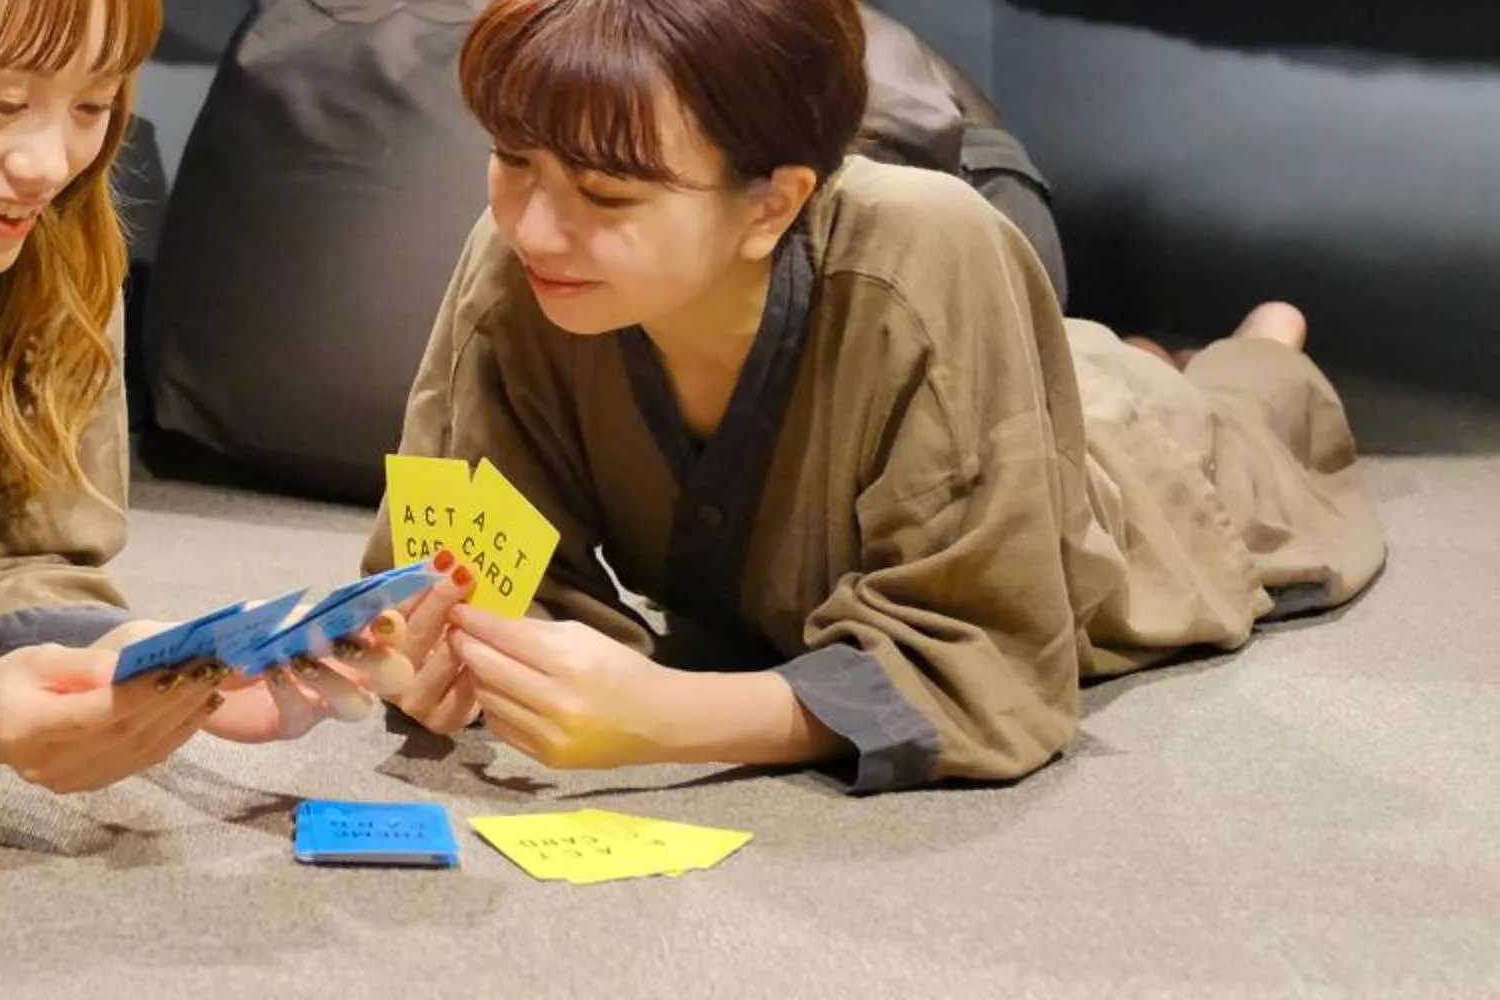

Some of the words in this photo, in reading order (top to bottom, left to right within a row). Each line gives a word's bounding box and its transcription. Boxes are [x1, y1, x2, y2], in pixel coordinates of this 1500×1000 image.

[403, 504, 456, 528] ACT
[405, 537, 445, 558] CA
[472, 511, 528, 569] ACT
[461, 536, 513, 597] CARD
